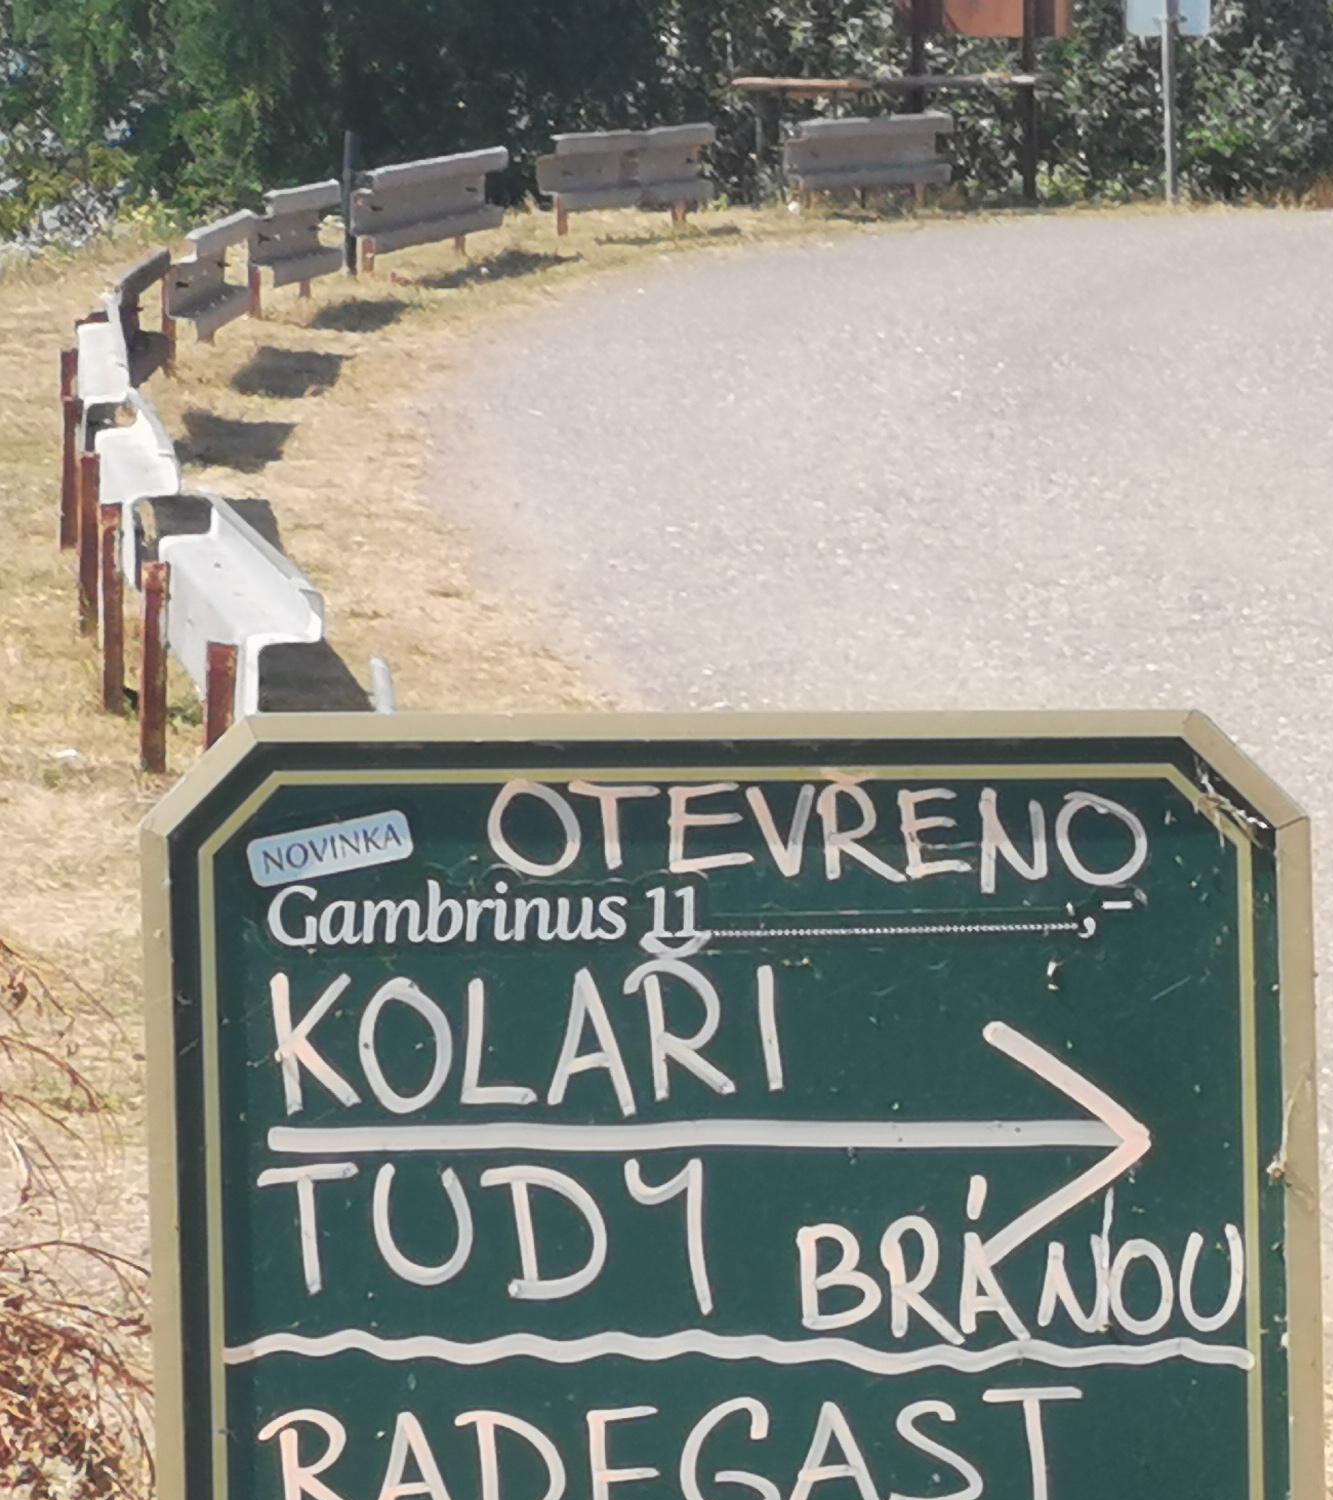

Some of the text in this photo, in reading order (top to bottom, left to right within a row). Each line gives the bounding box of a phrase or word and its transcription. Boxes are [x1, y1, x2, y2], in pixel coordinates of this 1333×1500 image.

[261, 823, 402, 874] NOVINKA
[267, 879, 627, 946] Gambrinus
[645, 885, 697, 937] 11
[270, 933, 783, 1117] KOLAŘI
[257, 1157, 712, 1315] TUDY
[797, 1174, 1245, 1345] BRÁNOU
